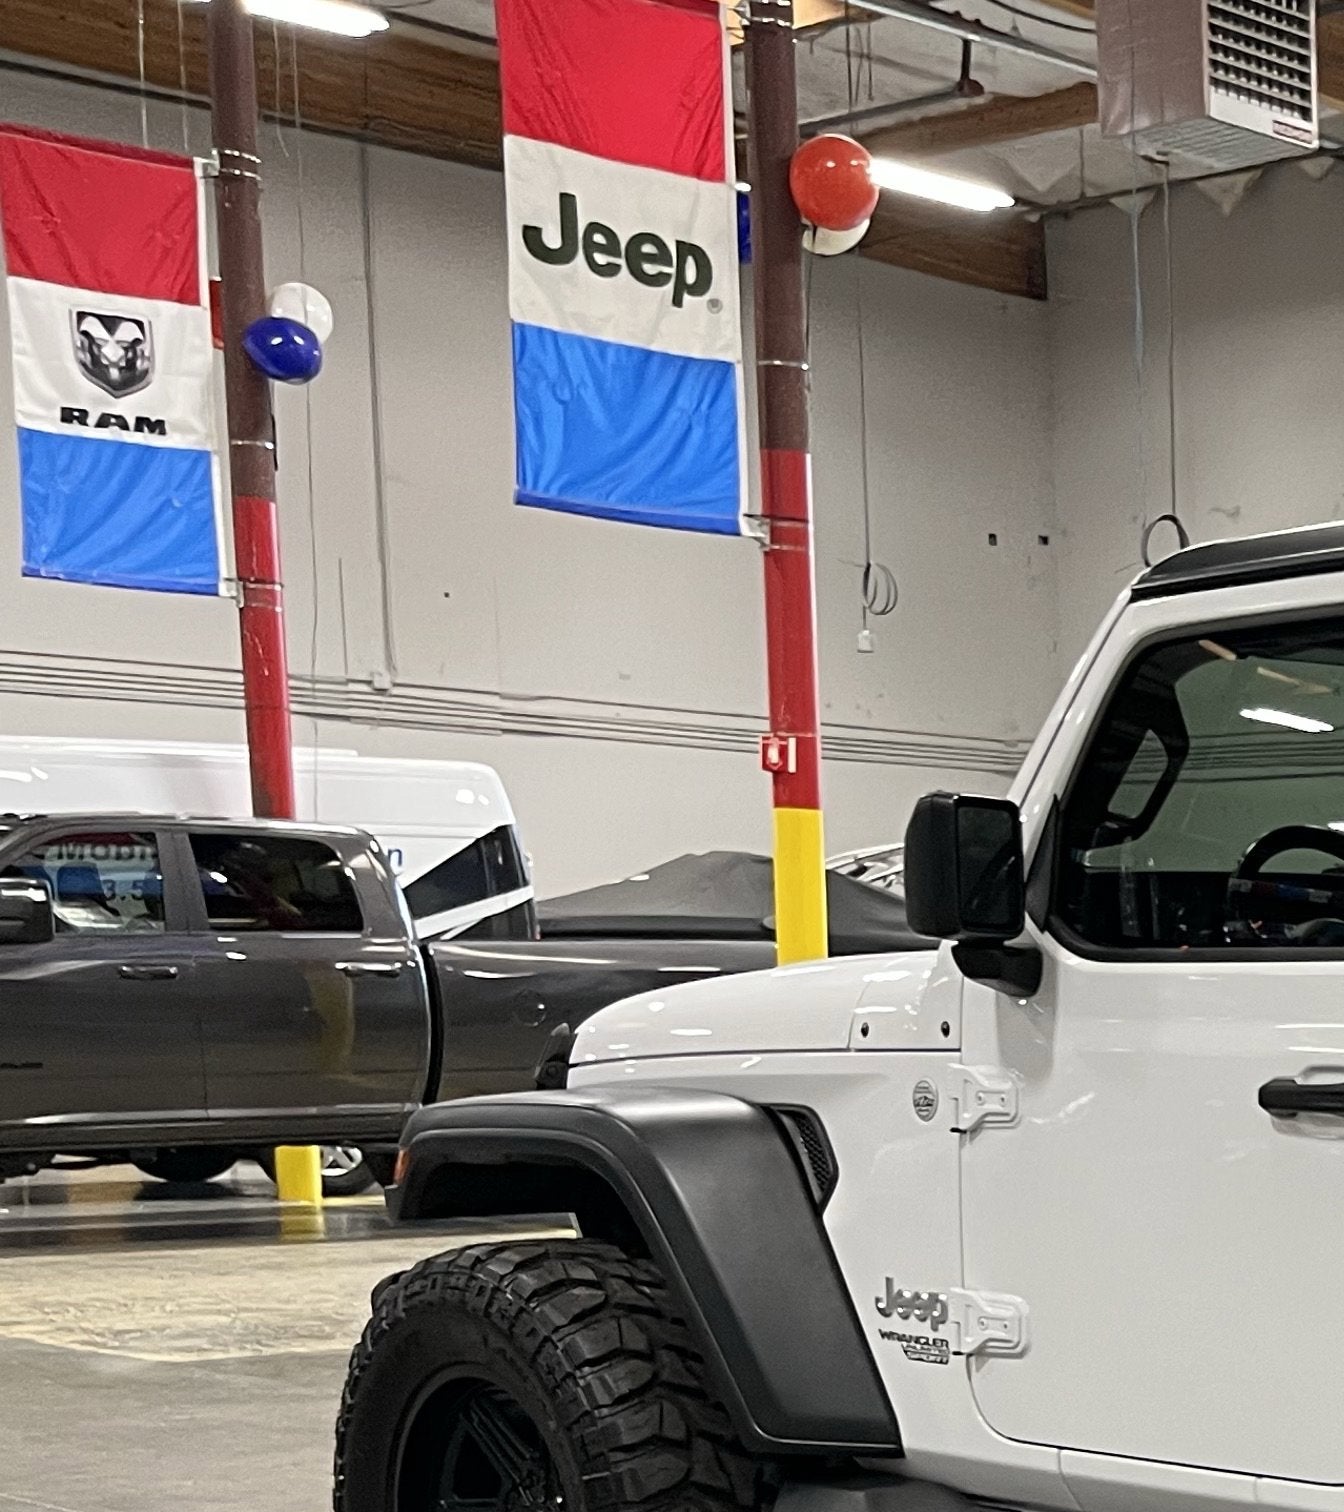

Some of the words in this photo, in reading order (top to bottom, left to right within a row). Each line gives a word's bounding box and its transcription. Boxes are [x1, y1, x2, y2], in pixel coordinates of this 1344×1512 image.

[522, 192, 713, 308] Jeep
[60, 406, 166, 435] RAM
[875, 1277, 948, 1332] Jeep
[878, 1328, 949, 1349] WRANGLER
